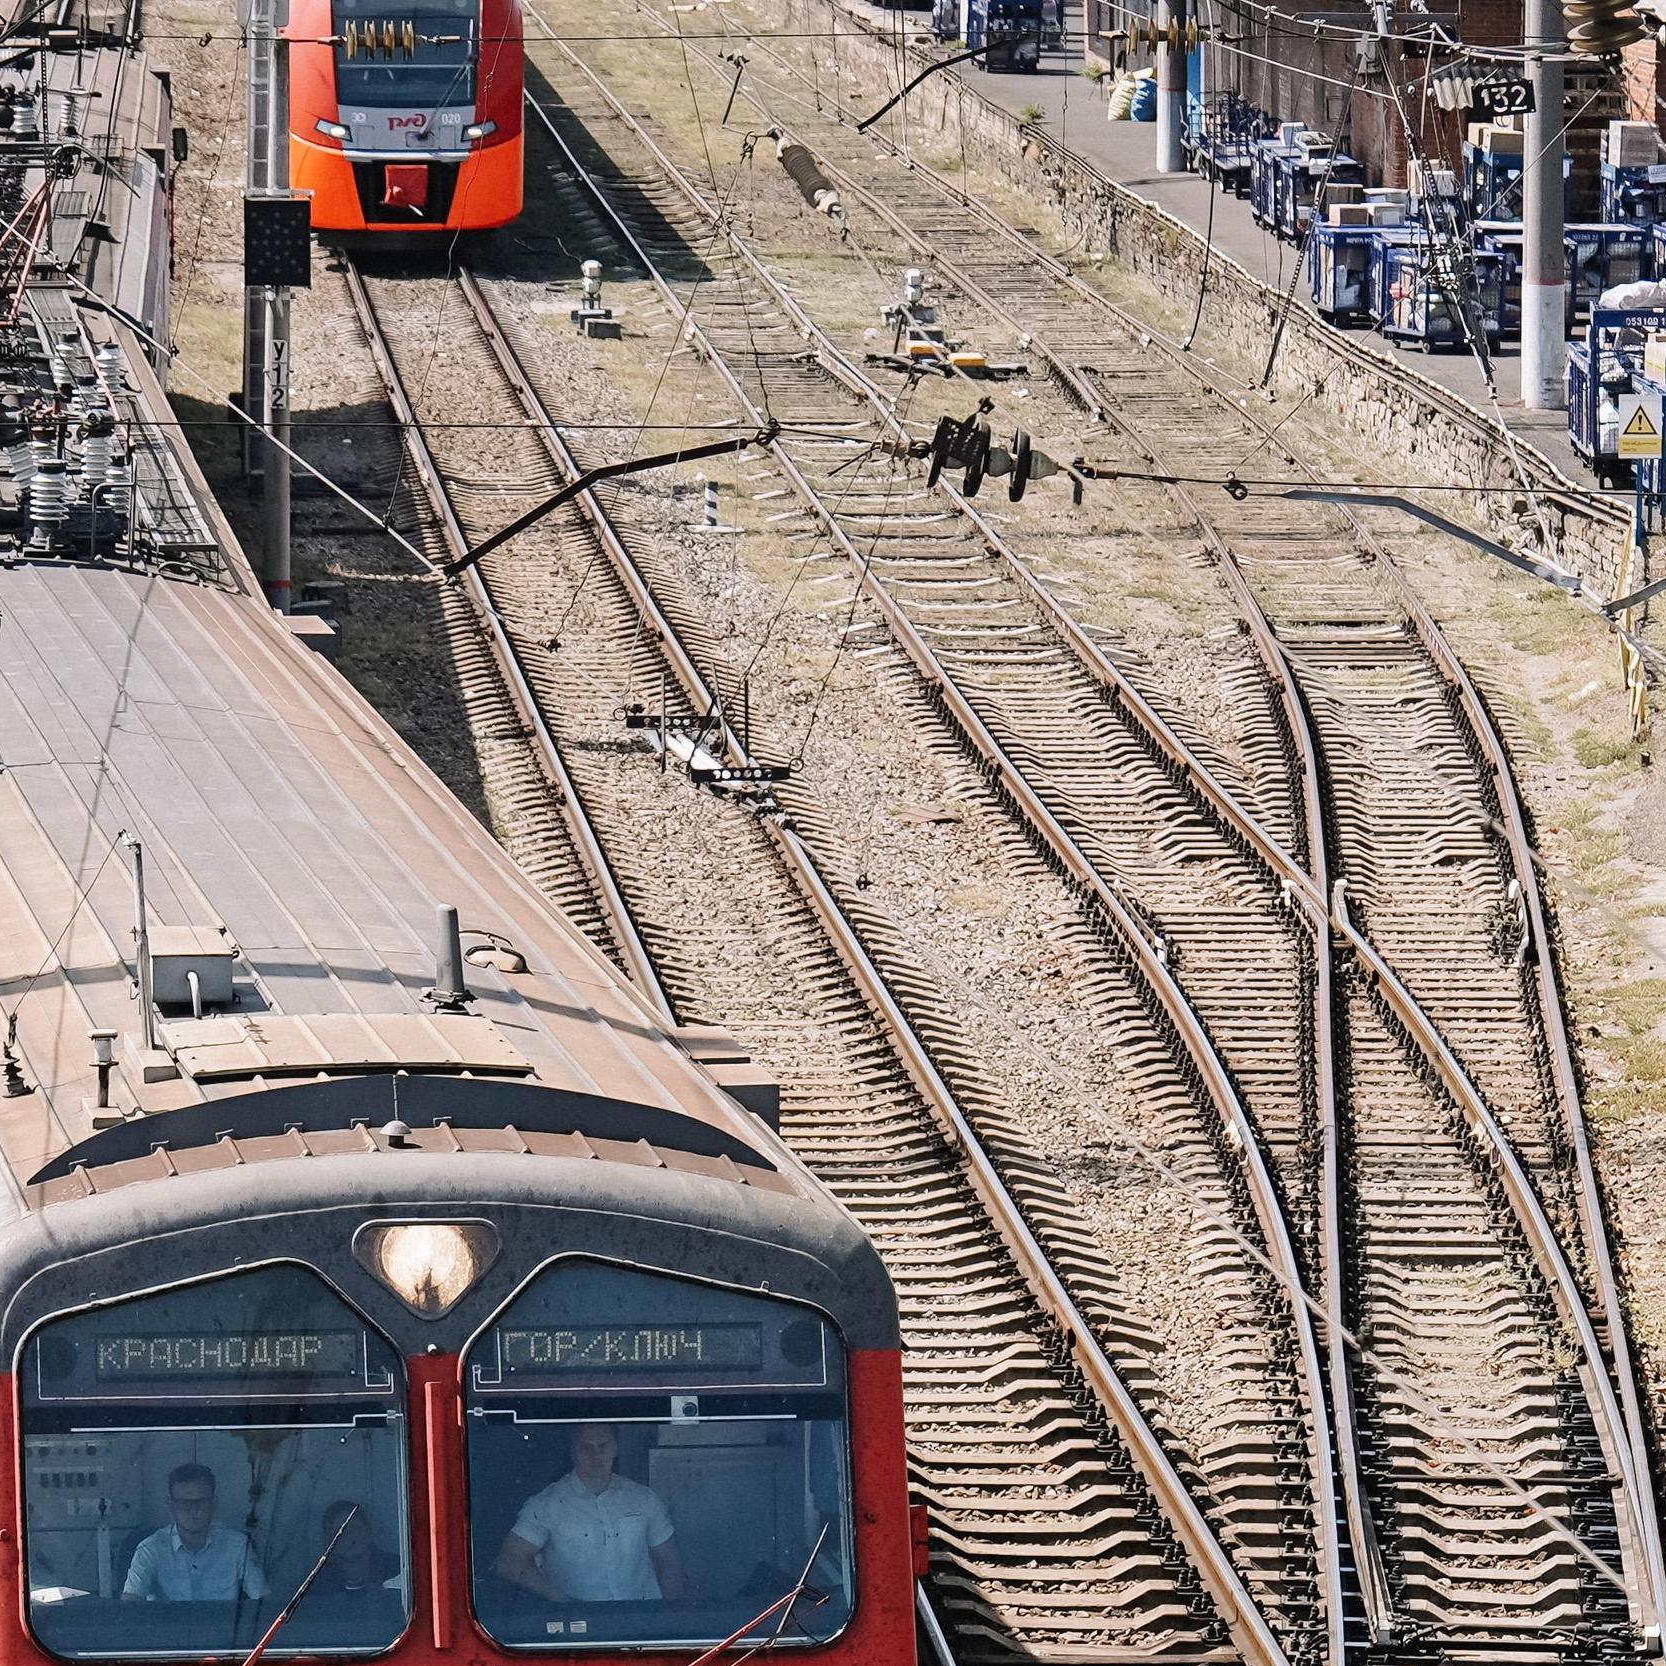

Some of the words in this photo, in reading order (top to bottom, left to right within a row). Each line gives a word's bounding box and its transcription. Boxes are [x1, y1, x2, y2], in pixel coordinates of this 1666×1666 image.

[1481, 85, 1527, 112] 132
[99, 1335, 322, 1369] КРАСНОДАР
[505, 1330, 702, 1362] ГОР/КЛЮЧ
